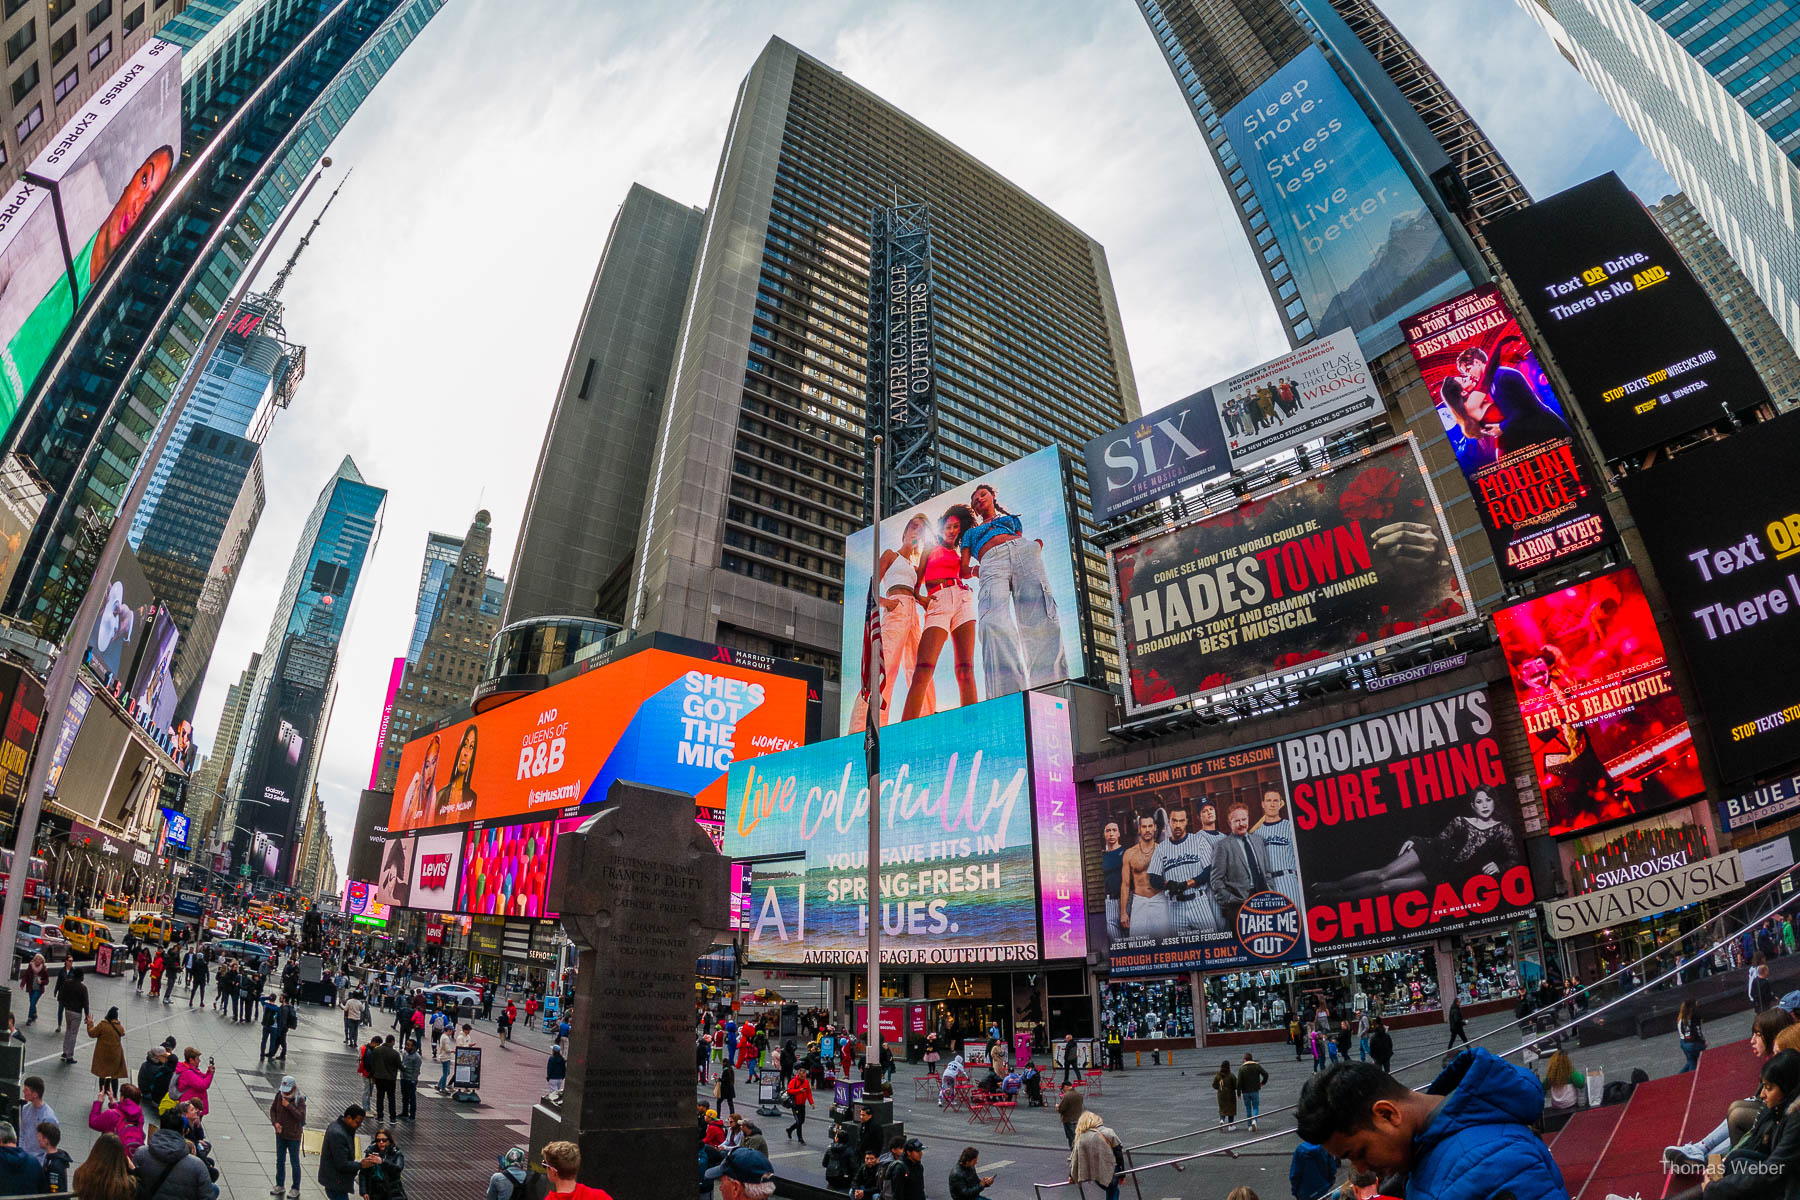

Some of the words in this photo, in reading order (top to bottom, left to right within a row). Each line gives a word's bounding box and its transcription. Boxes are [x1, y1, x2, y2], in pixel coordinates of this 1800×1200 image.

[100, 64, 145, 106] EXPRESS
[1243, 79, 1309, 133] Sleep
[47, 112, 98, 165] EXPRESS
[1253, 97, 1323, 151] more.
[1267, 117, 1342, 178] Stress
[1275, 158, 1335, 199] less.
[1292, 186, 1347, 231] Live
[1302, 187, 1399, 255] better.
[890, 264, 907, 315] EAGLE
[1545, 275, 1583, 299] Text
[1582, 266, 1608, 287] OR
[1604, 251, 1649, 274] Drive.
[1550, 294, 1597, 321] There
[1598, 287, 1611, 303] Is
[1613, 279, 1634, 297] No
[1634, 264, 1671, 290] AND.
[1409, 326, 1422, 340] 10
[1422, 313, 1452, 334] TONY
[1454, 294, 1497, 321] AWARDS
[1418, 294, 1478, 321] WINNER!
[911, 283, 930, 393] OUTFITTERS
[1416, 338, 1448, 358] BEST
[1447, 310, 1507, 344] MUSICAL!
[890, 322, 908, 423] AMERICAN
[1228, 366, 1267, 387] BROADWAY'S
[1268, 355, 1297, 369] FUNNIEST
[1298, 345, 1320, 358] SMASH
[1320, 340, 1331, 349] HIT
[1229, 384, 1242, 393] AND
[1243, 364, 1291, 387] INTERNATIONAL
[1291, 346, 1335, 367] PHENOMENON
[1300, 375, 1326, 390] THAT
[1326, 358, 1362, 380] GOES
[1303, 366, 1322, 380] THE
[1322, 352, 1351, 371] PLAY
[1602, 350, 1717, 402] STOPTEXTSSTOPWRECKS.ORG
[1303, 372, 1366, 401] WRONG
[1247, 441, 1262, 451] NEW
[1262, 433, 1284, 445] WORLD
[1285, 424, 1307, 437] STAGES
[1310, 418, 1323, 427] 340
[1345, 401, 1367, 414] STREET
[1104, 409, 1208, 492] SIX
[1132, 482, 1148, 494] THE
[1151, 465, 1188, 486] MUSICAL
[1478, 450, 1564, 502] MOULIN
[1154, 565, 1178, 584] COME
[1180, 560, 1197, 577] SEE
[1197, 554, 1219, 572] HOW
[1219, 548, 1238, 566] THE
[1238, 535, 1271, 562] WORLD
[1272, 525, 1303, 550] COULD
[1304, 521, 1321, 537] BE.
[1507, 533, 1556, 566] AARON
[1558, 516, 1604, 546] TVEIT
[1517, 553, 1551, 570] THRU
[1554, 540, 1592, 558] APRIL
[1689, 532, 1766, 582] Text
[1131, 520, 1372, 642] HADESTOWN
[1136, 624, 1204, 656] BROADWAY'S
[1238, 603, 1261, 625] AND
[1199, 630, 1238, 655] BEST
[1240, 607, 1317, 647] MUSICAL
[1694, 588, 1788, 640] There
[735, 658, 771, 670] MARQUIS
[736, 651, 776, 664] MARRIOTT
[683, 669, 766, 705] SHE'S
[537, 708, 558, 727] AND
[682, 696, 744, 722] GOT
[1524, 708, 1561, 734] LIFE
[1562, 702, 1580, 723] IS
[1585, 716, 1599, 725] NEW
[1600, 711, 1616, 721] YORK
[1617, 705, 1636, 716] TIMES
[522, 726, 554, 747] QUEENS
[555, 722, 569, 737] OF
[680, 717, 737, 748] THE
[1285, 690, 1493, 781] BROADWAY'S
[517, 738, 566, 780] R&B
[677, 741, 735, 771] MIC
[1097, 782, 1116, 795] THE
[1117, 772, 1170, 790] HOME-RUN
[1171, 766, 1188, 780] HIT
[1190, 762, 1203, 775] OF
[1206, 757, 1227, 772] THE
[1229, 747, 1275, 768] SEASON!
[265, 786, 285, 796] Galaxy
[737, 766, 797, 837] Live
[801, 750, 1027, 849] colorfully
[1293, 763, 1388, 831] SURE
[1388, 737, 1506, 811] THING
[1726, 783, 1785, 817] BLUE
[1731, 802, 1785, 827] SEAFOOD
[879, 844, 925, 867] FAVE
[929, 837, 972, 861] FITS
[978, 833, 1000, 852] IN
[1163, 854, 1201, 872] Empires
[1595, 850, 1689, 889] SWAROVSKI
[603, 865, 650, 883] FRANCIS
[665, 876, 703, 889] DUFFY
[826, 863, 1000, 902] SPRNG-FRESH
[1051, 800, 1073, 945] AMERICAN
[1306, 865, 1535, 944] CHICAGO
[1433, 908, 1447, 916] THE
[1449, 902, 1481, 913] MUSICAL
[1555, 855, 1741, 933] SWAROVSKI
[1161, 937, 1180, 946] JESSE
[1181, 935, 1200, 944] TYLER
[1200, 931, 1233, 943] FERGUSON
[1239, 911, 1274, 935] TAKE
[1277, 911, 1298, 933] ME
[1313, 936, 1396, 953] CHICAGOTHEMUSICAL.COM
[1442, 922, 1465, 932] THEATRE
[1481, 916, 1499, 925] STREET
[1506, 908, 1536, 919] BROADWAY
[879, 948, 926, 964] EAGLE
[931, 945, 1036, 965] OUTFITTERS
[1110, 941, 1127, 950] JESSE
[1128, 939, 1157, 949] WILLIAMS
[1110, 954, 1152, 967] THROUGH
[1154, 950, 1201, 964] FEBRUARY
[1204, 949, 1211, 959] 5
[1213, 946, 1238, 958] ONLY
[1253, 937, 1284, 954] OUT
[1339, 952, 1400, 977] SLAM
[947, 977, 974, 996] AE
